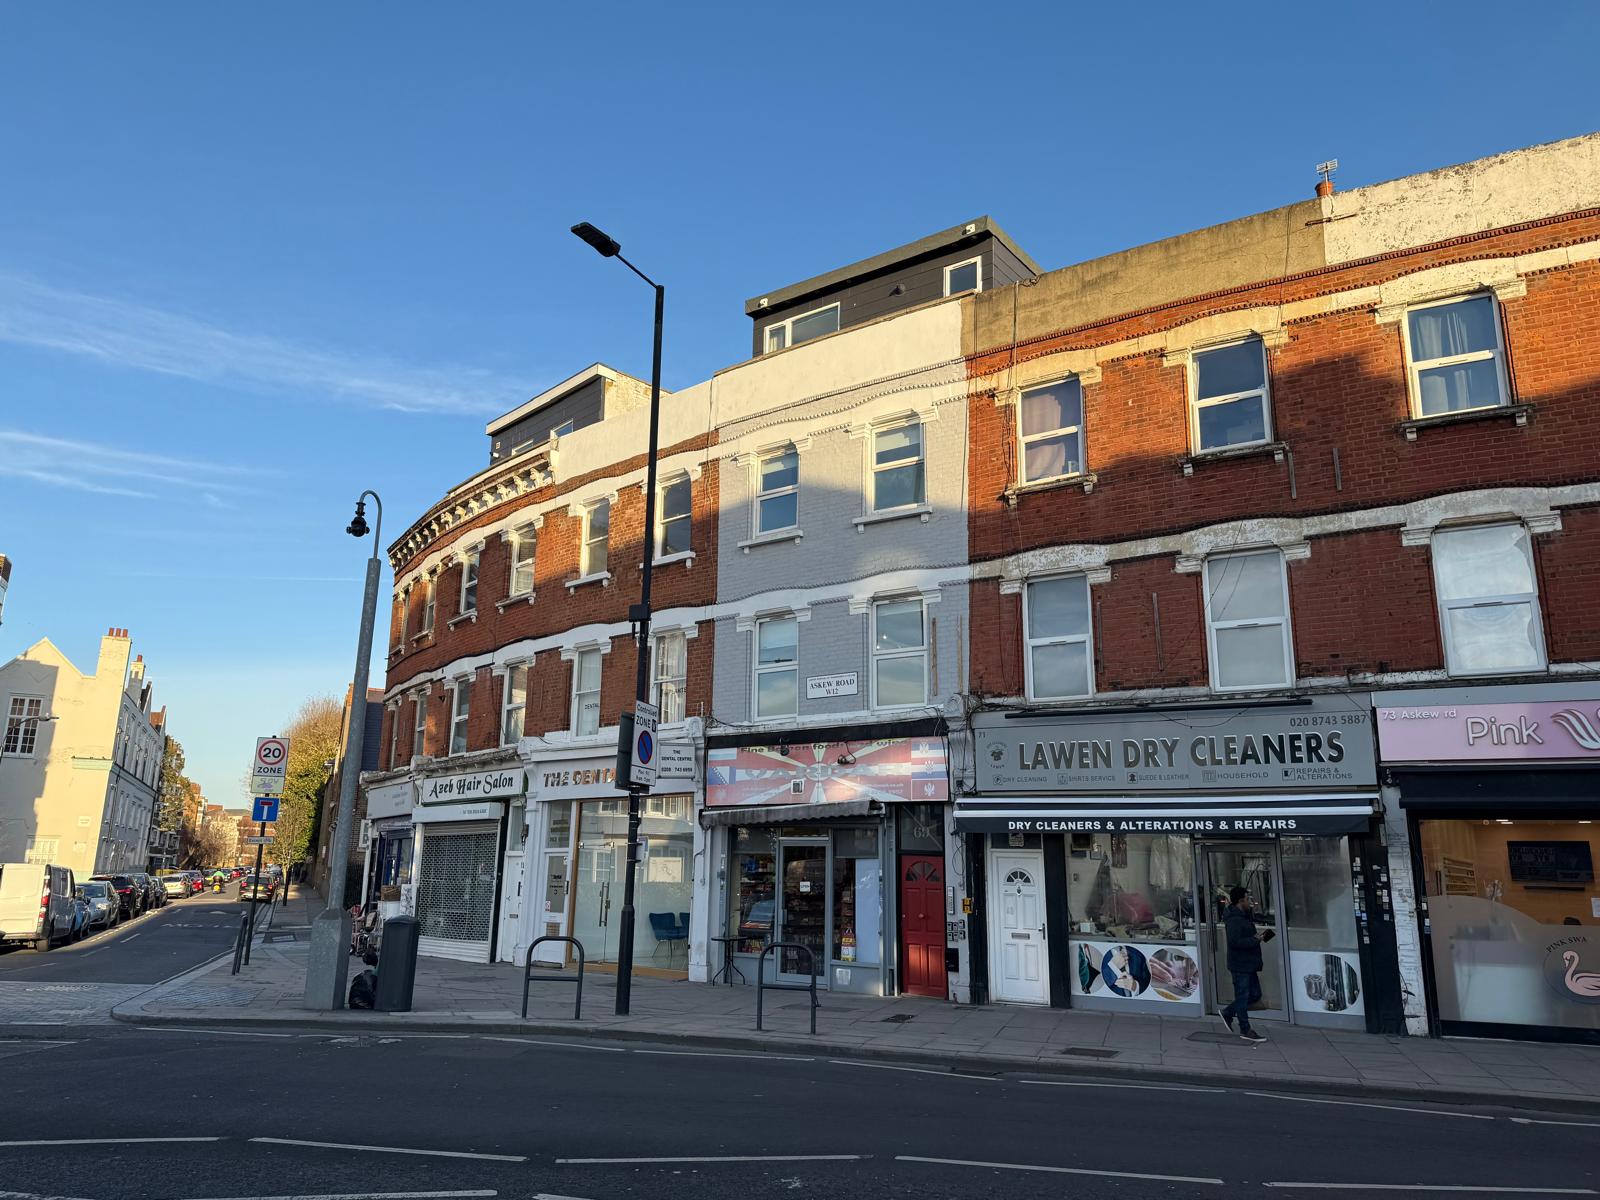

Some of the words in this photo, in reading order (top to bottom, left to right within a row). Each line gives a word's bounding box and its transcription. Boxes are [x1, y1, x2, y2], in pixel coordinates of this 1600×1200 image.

[810, 680, 832, 689] ASKEW
[835, 679, 855, 687] ROAD
[636, 703, 657, 718] Controlled
[1383, 711, 1396, 720] 73
[1401, 709, 1439, 719] Askew
[1444, 708, 1457, 718] rd
[635, 715, 651, 729] ZONE
[1289, 717, 1309, 727] 020
[1312, 715, 1338, 726] 8743
[1340, 714, 1367, 725] 5887
[1465, 715, 1544, 746] Pink
[262, 747, 282, 759] 20
[1018, 739, 1113, 771] LAWEN
[1122, 737, 1181, 769] DRY
[1190, 730, 1345, 767] CLEANERS
[257, 766, 283, 774] ZONE
[1217, 771, 1269, 779] HOUSEHOLD
[543, 771, 570, 788] THE
[572, 767, 617, 786] DENTA
[1016, 775, 1048, 783] CLEANING
[429, 780, 454, 799] Azeb
[456, 776, 482, 795] Hair
[482, 772, 514, 795] Salon
[1008, 821, 1032, 831] DRY
[1036, 820, 1101, 831] CLEANERS
[1106, 821, 1115, 830] &
[1119, 820, 1214, 831] ALTERATIONS
[1219, 820, 1229, 830] &
[1234, 819, 1297, 830] REPAIRS
[913, 827, 930, 839] 69
[1546, 938, 1566, 954] PINK
[1567, 936, 1588, 944] SWA
